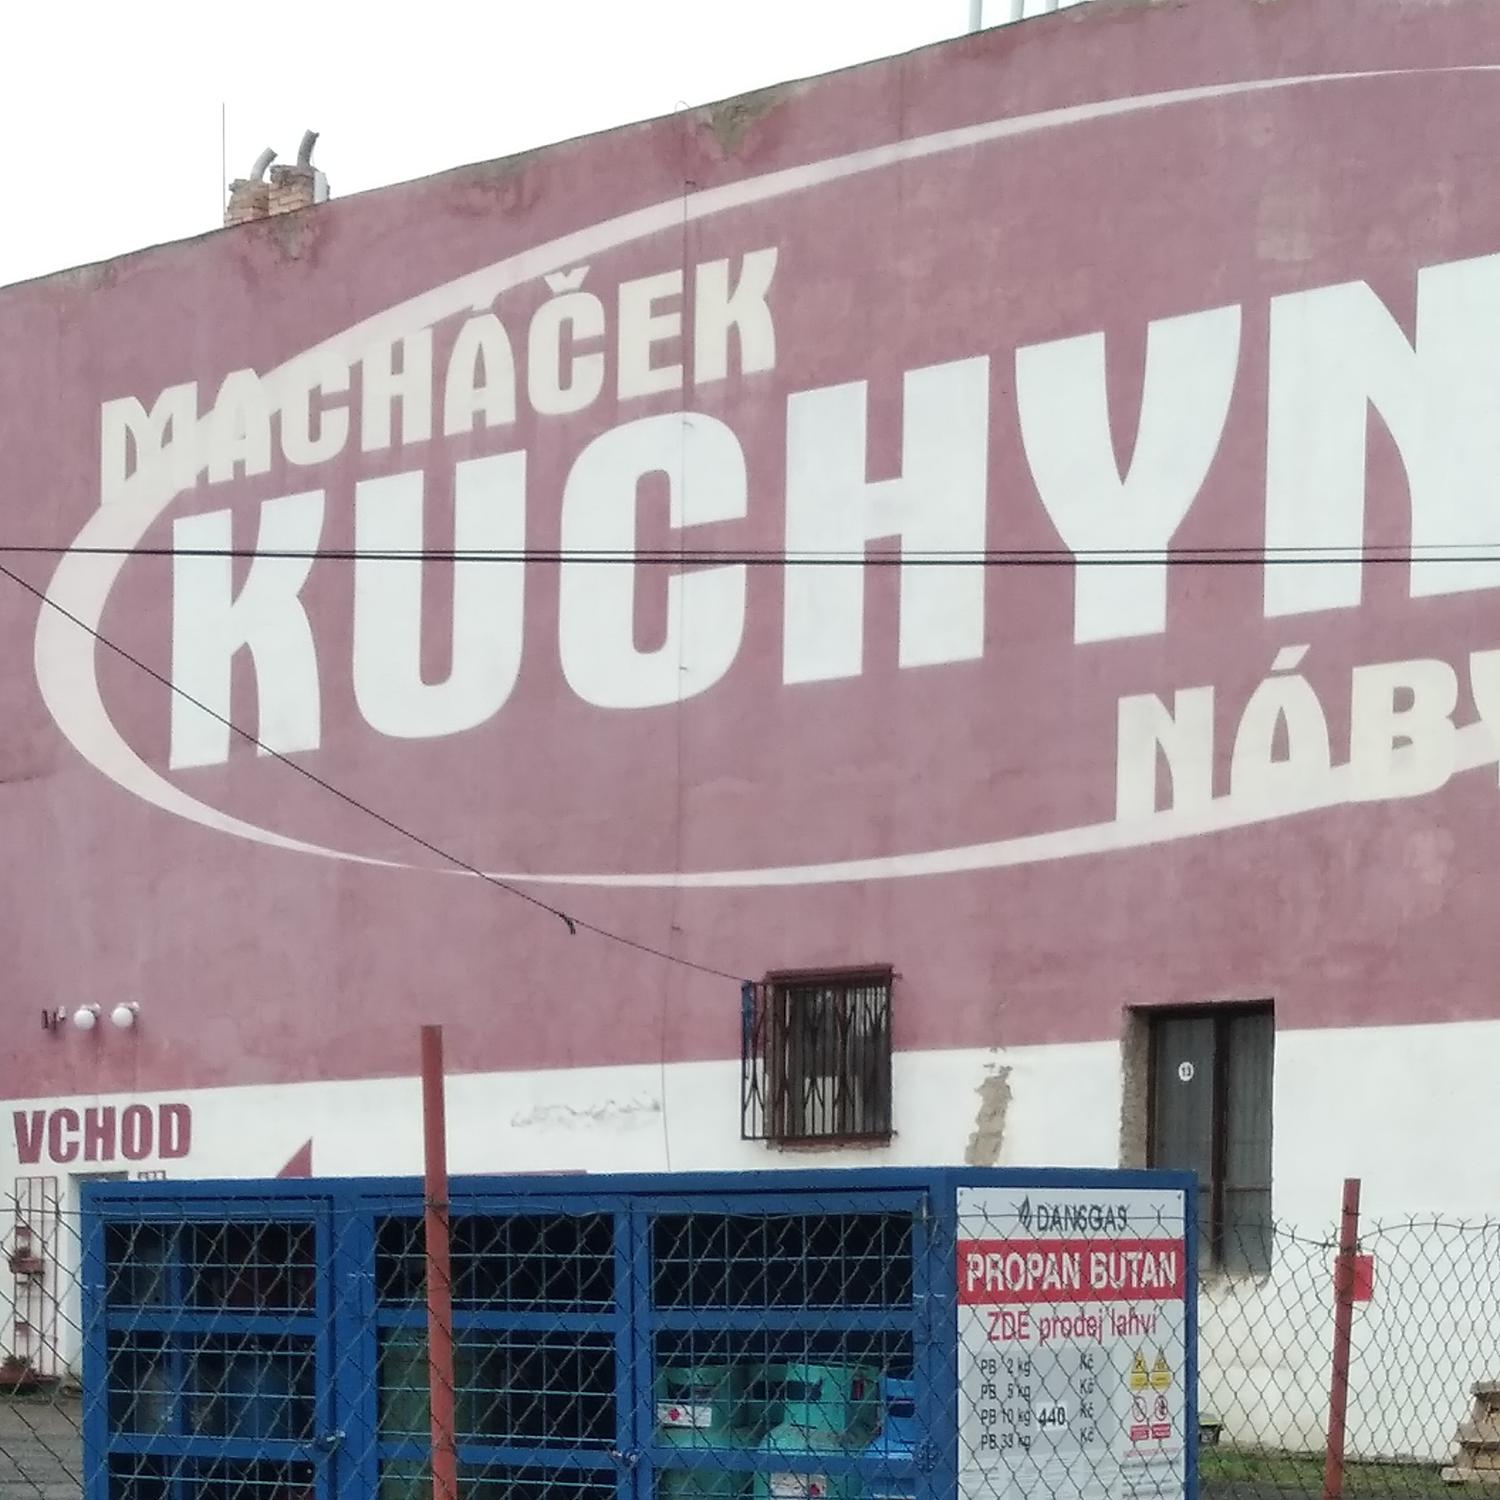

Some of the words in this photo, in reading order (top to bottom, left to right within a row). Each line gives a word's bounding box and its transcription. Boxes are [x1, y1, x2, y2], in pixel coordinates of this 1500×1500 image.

[101, 246, 778, 508] MACHÁČEK
[13, 1103, 192, 1164] VCHOD
[1036, 1205, 1127, 1232] DANSGAS
[966, 1253, 1080, 1292] PROPAN
[1090, 1251, 1176, 1289] BUTAN
[987, 1310, 1031, 1342] ZDE
[1039, 1306, 1102, 1346] prodej
[1111, 1305, 1160, 1337] lahví
[981, 1358, 996, 1375] PB
[1018, 1357, 1031, 1377] kg
[981, 1384, 996, 1400] PB
[1018, 1382, 1031, 1401] kg
[981, 1408, 996, 1425] PB
[1002, 1408, 1014, 1424] 10
[1018, 1408, 1031, 1427] kg
[1039, 1406, 1066, 1426] 440
[981, 1433, 996, 1451] PB
[1018, 1433, 1031, 1452] kg
